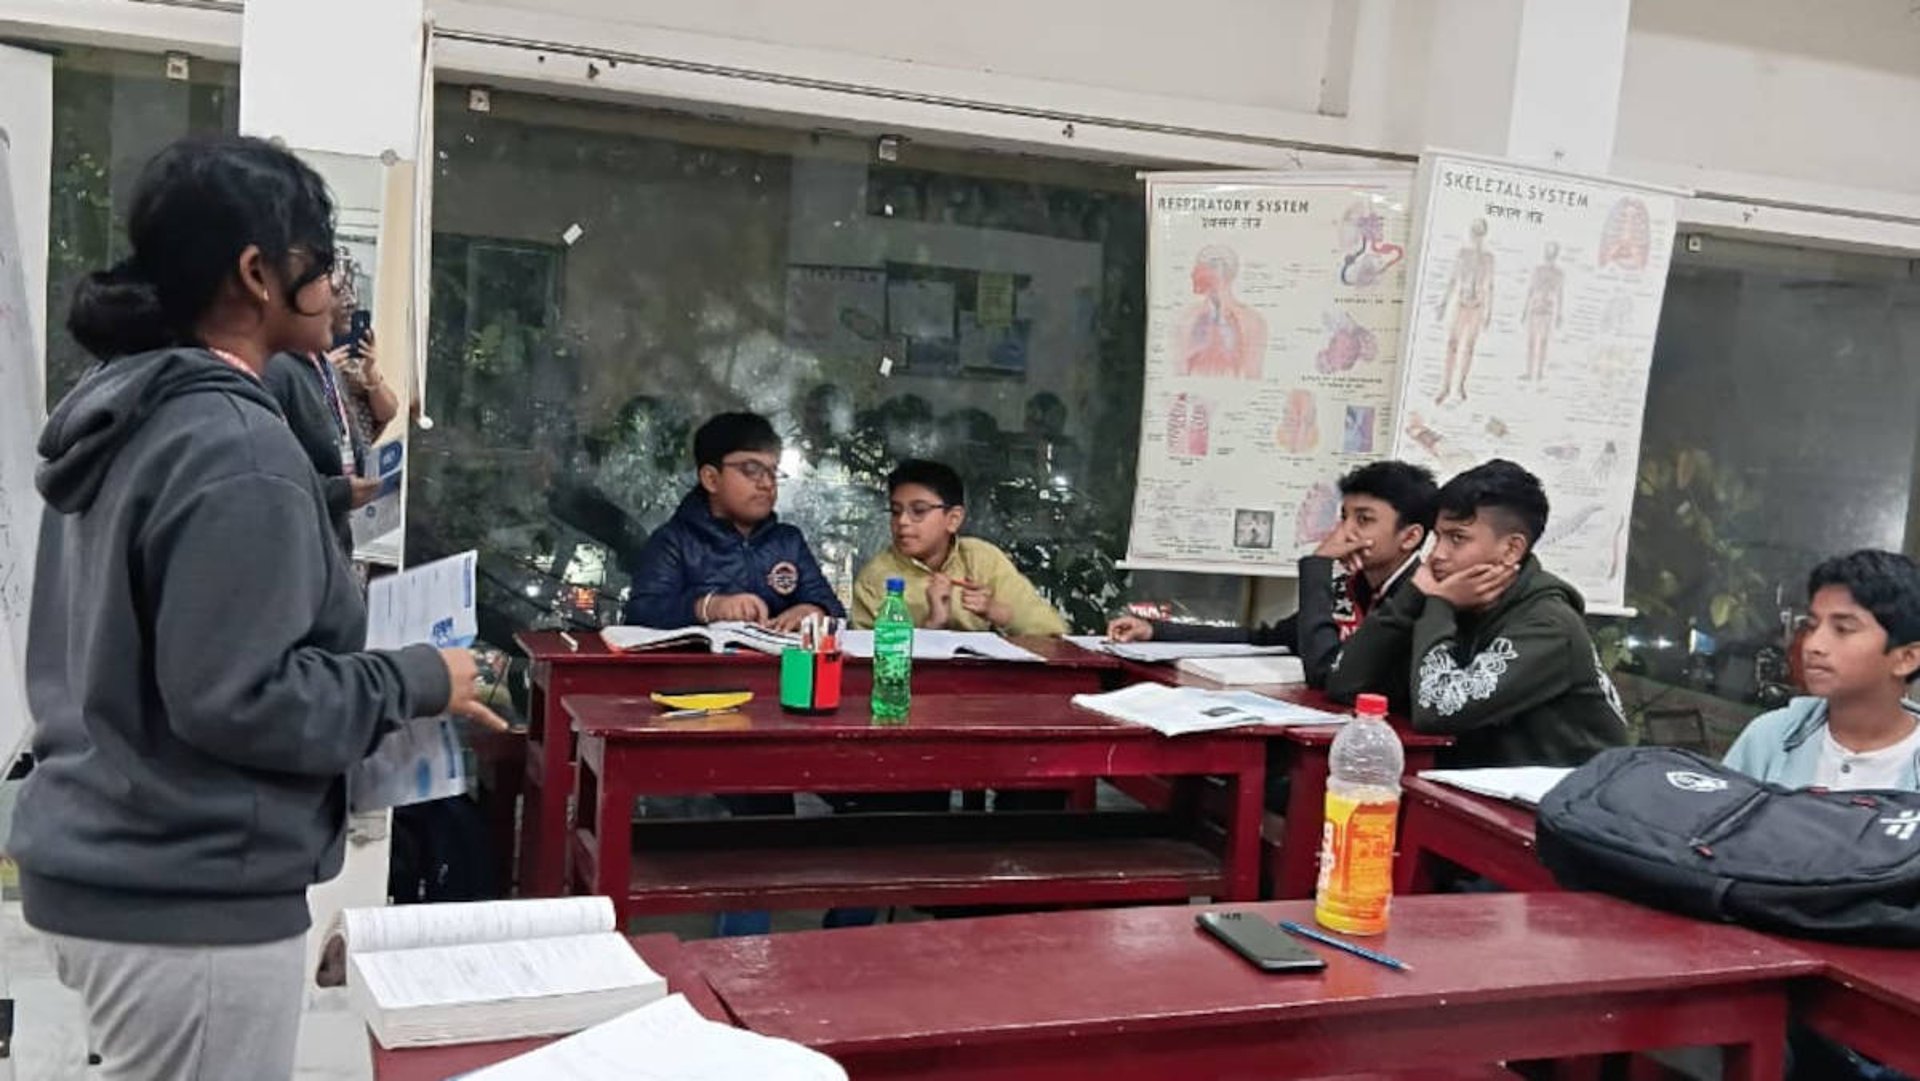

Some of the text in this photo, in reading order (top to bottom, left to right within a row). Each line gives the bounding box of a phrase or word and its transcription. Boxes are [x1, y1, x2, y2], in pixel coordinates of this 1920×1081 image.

[1444, 171, 1589, 208] SKELETAL SYSTEM
[1157, 197, 1309, 213] RESPIRATORY SYSTEM
